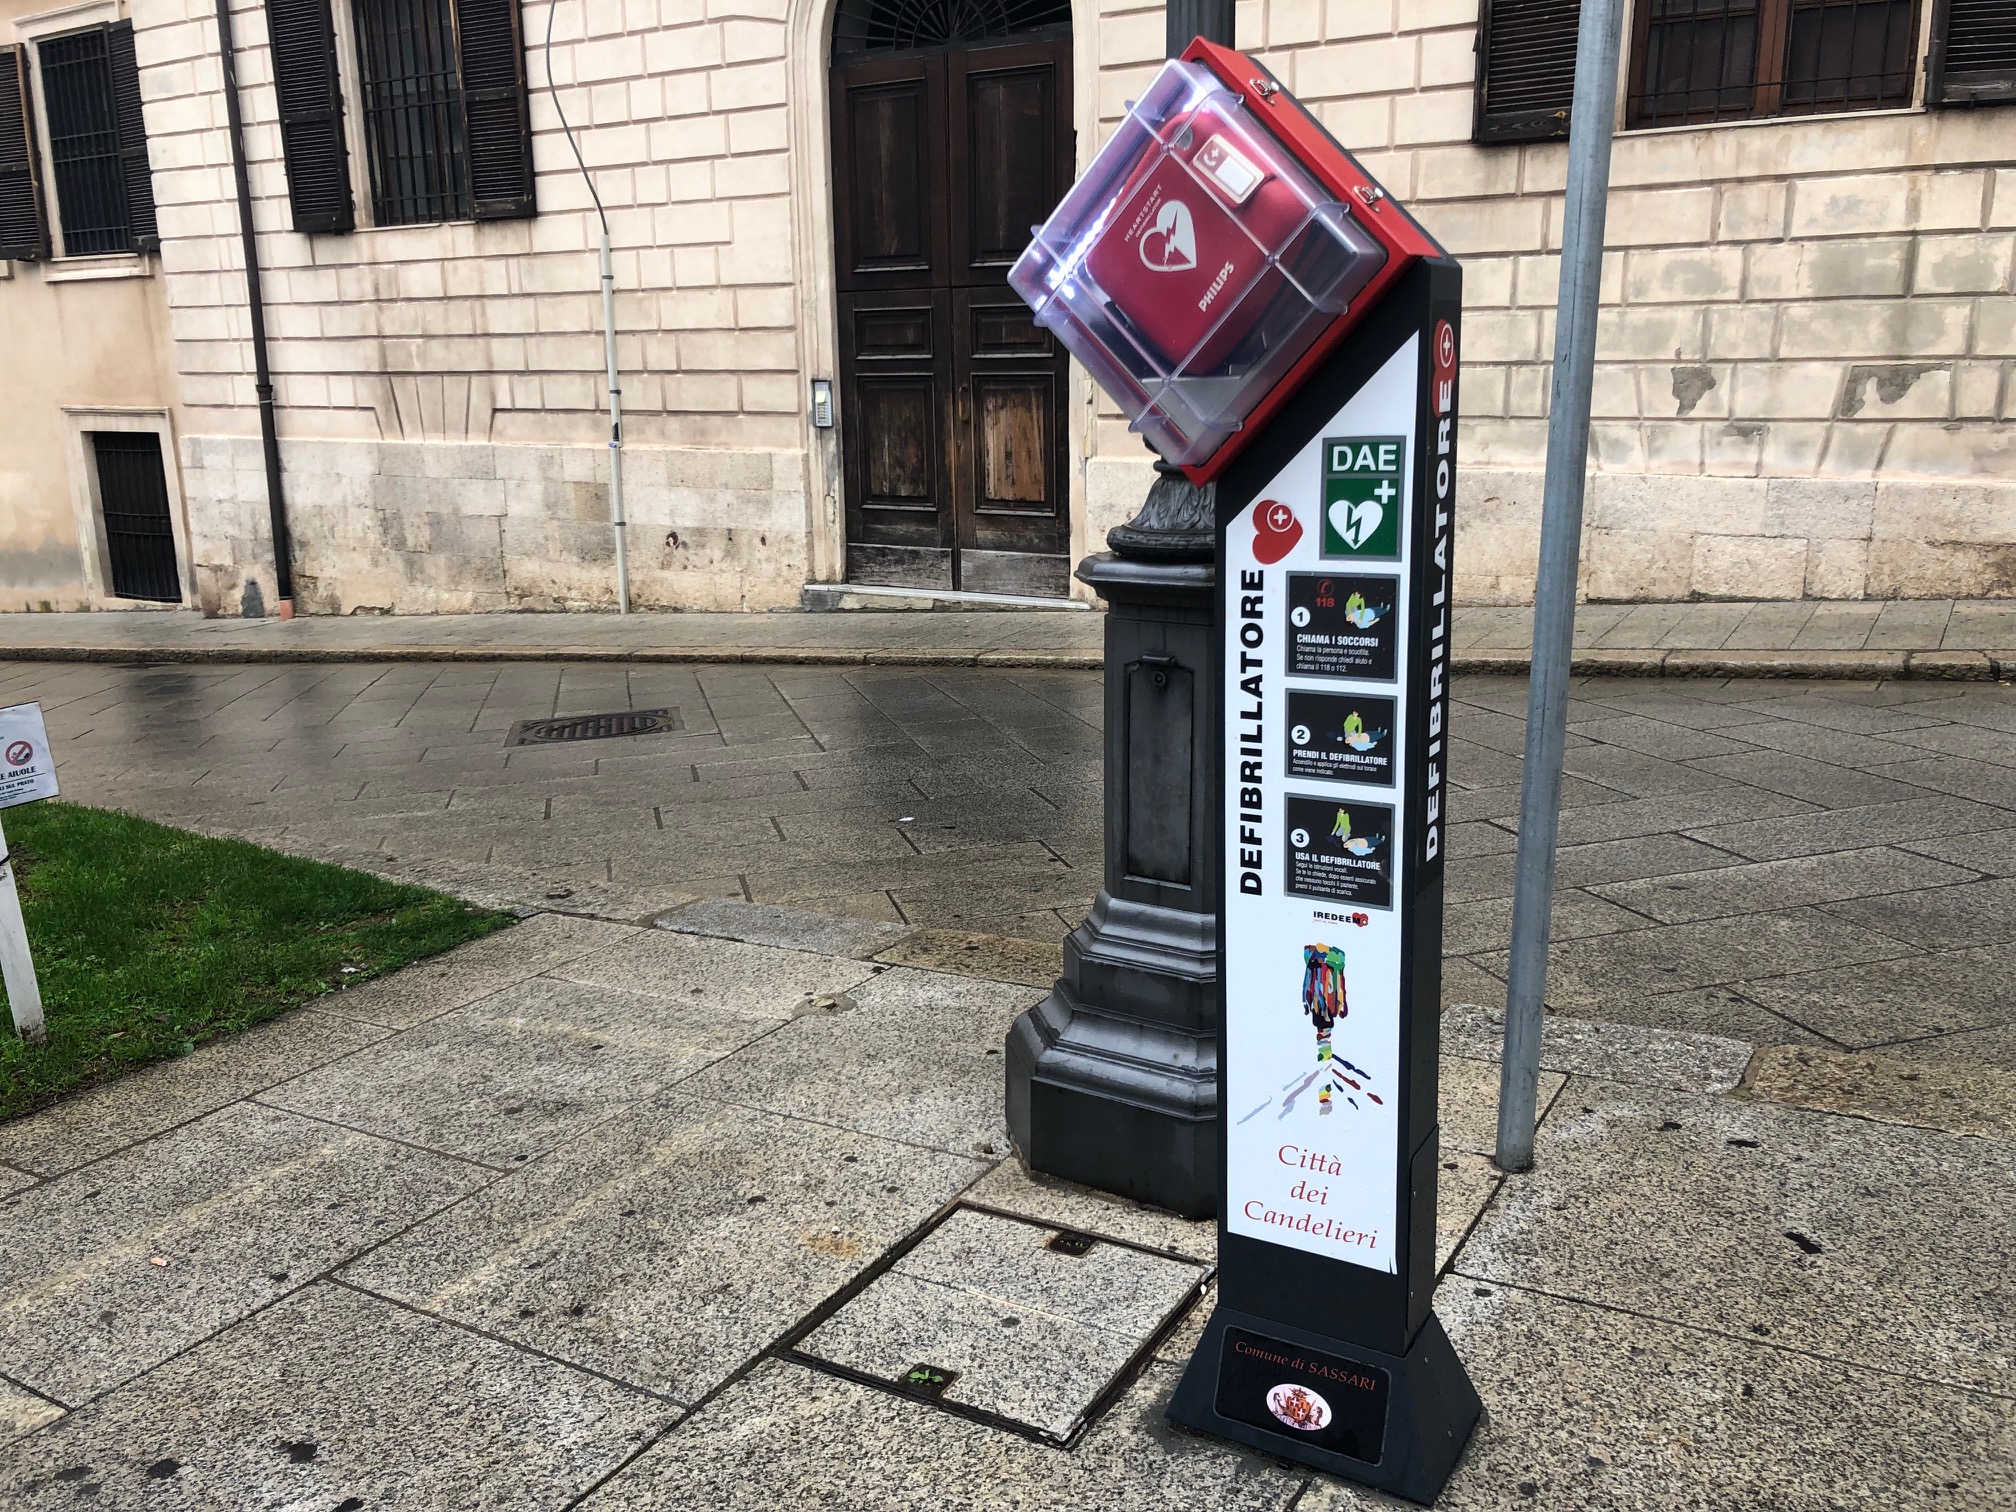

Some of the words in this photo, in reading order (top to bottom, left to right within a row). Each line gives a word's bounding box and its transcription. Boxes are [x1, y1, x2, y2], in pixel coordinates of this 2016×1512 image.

[1124, 183, 1162, 242] HEARTSTART
[1198, 260, 1235, 312] PHILIPS
[1332, 444, 1398, 472] DAE
[1315, 597, 1335, 608] 118
[1297, 611, 1304, 622] 1
[1426, 379, 1452, 863] DEFIBRILLATORE
[1297, 634, 1330, 644] CHIAMA
[1332, 636, 1335, 644] I
[1337, 635, 1378, 647] SOCCORSI
[1296, 662, 1314, 670] chiama
[1315, 655, 1337, 663] risponde
[1240, 569, 1264, 896] DEFIBRILLATORE
[1296, 729, 1305, 739] 2
[1293, 749, 1319, 759] PRENDI
[1321, 752, 1327, 760] IL
[1329, 752, 1387, 765] DEFIBRILLATORE
[1317, 760, 1332, 768] applica
[8, 766, 36, 778] AIUOLE
[17, 779, 35, 787] PRATO
[1296, 833, 1304, 843] 3
[1295, 852, 1310, 861] USA
[1320, 855, 1381, 870] DEFIBRILLATORE
[1313, 910, 1361, 925] IREDEEM
[1277, 1144, 1342, 1177] Città
[1290, 1180, 1328, 1206] dei
[1243, 1200, 1378, 1249] Candelieri
[1235, 1340, 1288, 1366] Comune
[1291, 1357, 1305, 1370] di
[1308, 1361, 1376, 1392] SASSARI
